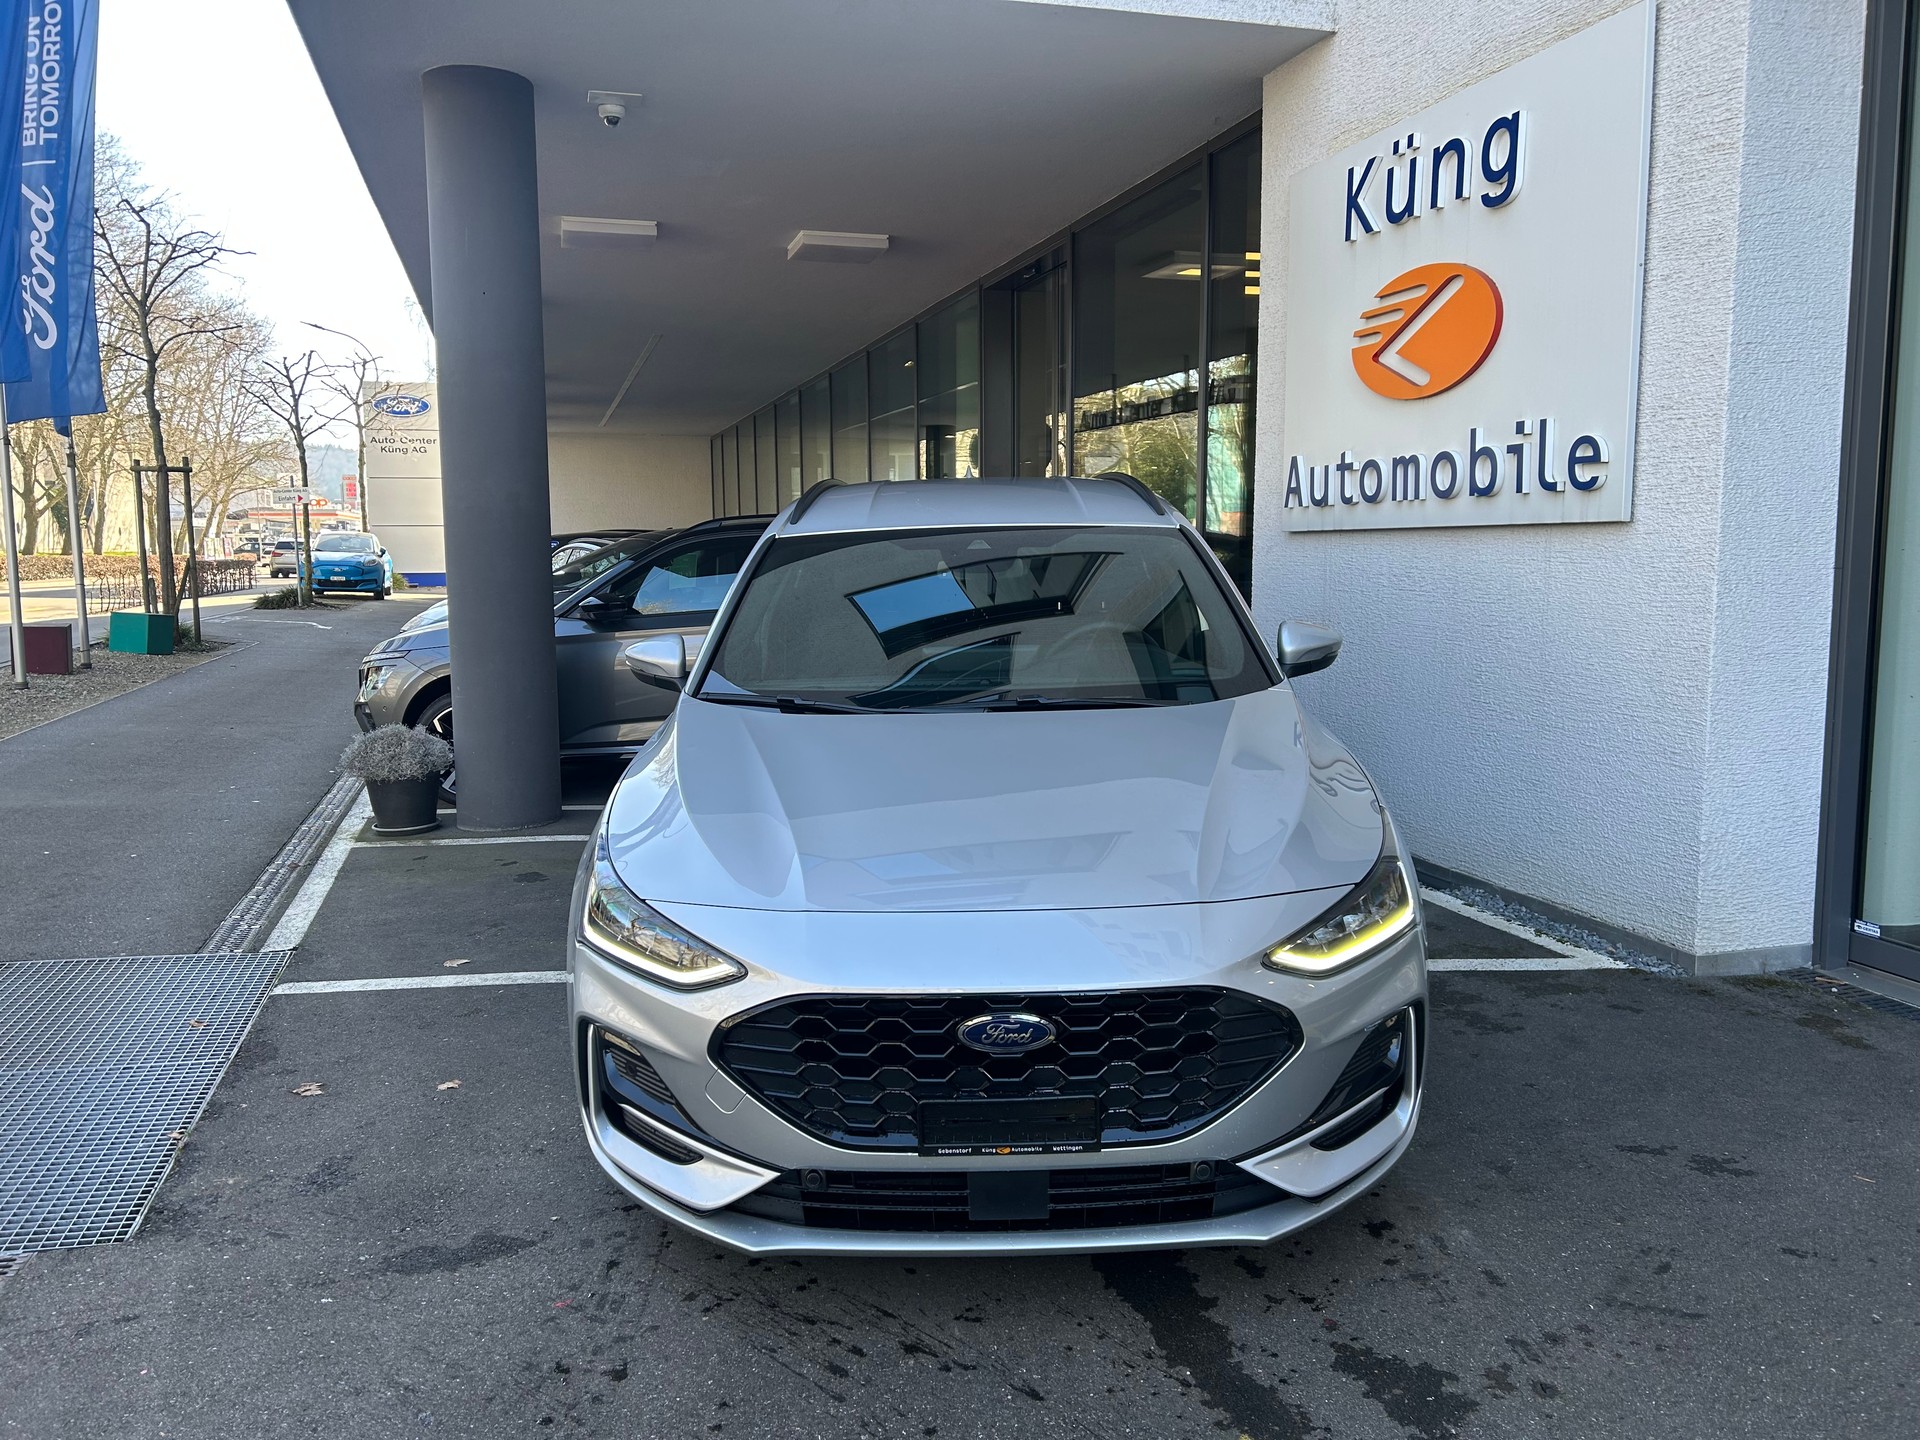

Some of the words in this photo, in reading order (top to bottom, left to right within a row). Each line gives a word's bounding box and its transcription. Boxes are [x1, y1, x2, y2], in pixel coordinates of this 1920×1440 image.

[27, 16, 41, 58] ON
[39, 0, 62, 146] TOMORRO
[22, 63, 39, 147] BRING
[1344, 109, 1526, 242] Küng
[21, 183, 57, 350] Ford
[380, 446, 408, 455] Küng
[411, 446, 428, 454] AG
[1284, 418, 1609, 509] Automobile
[981, 1023, 1034, 1044] Ford
[1052, 1144, 1083, 1152] Wettingen
